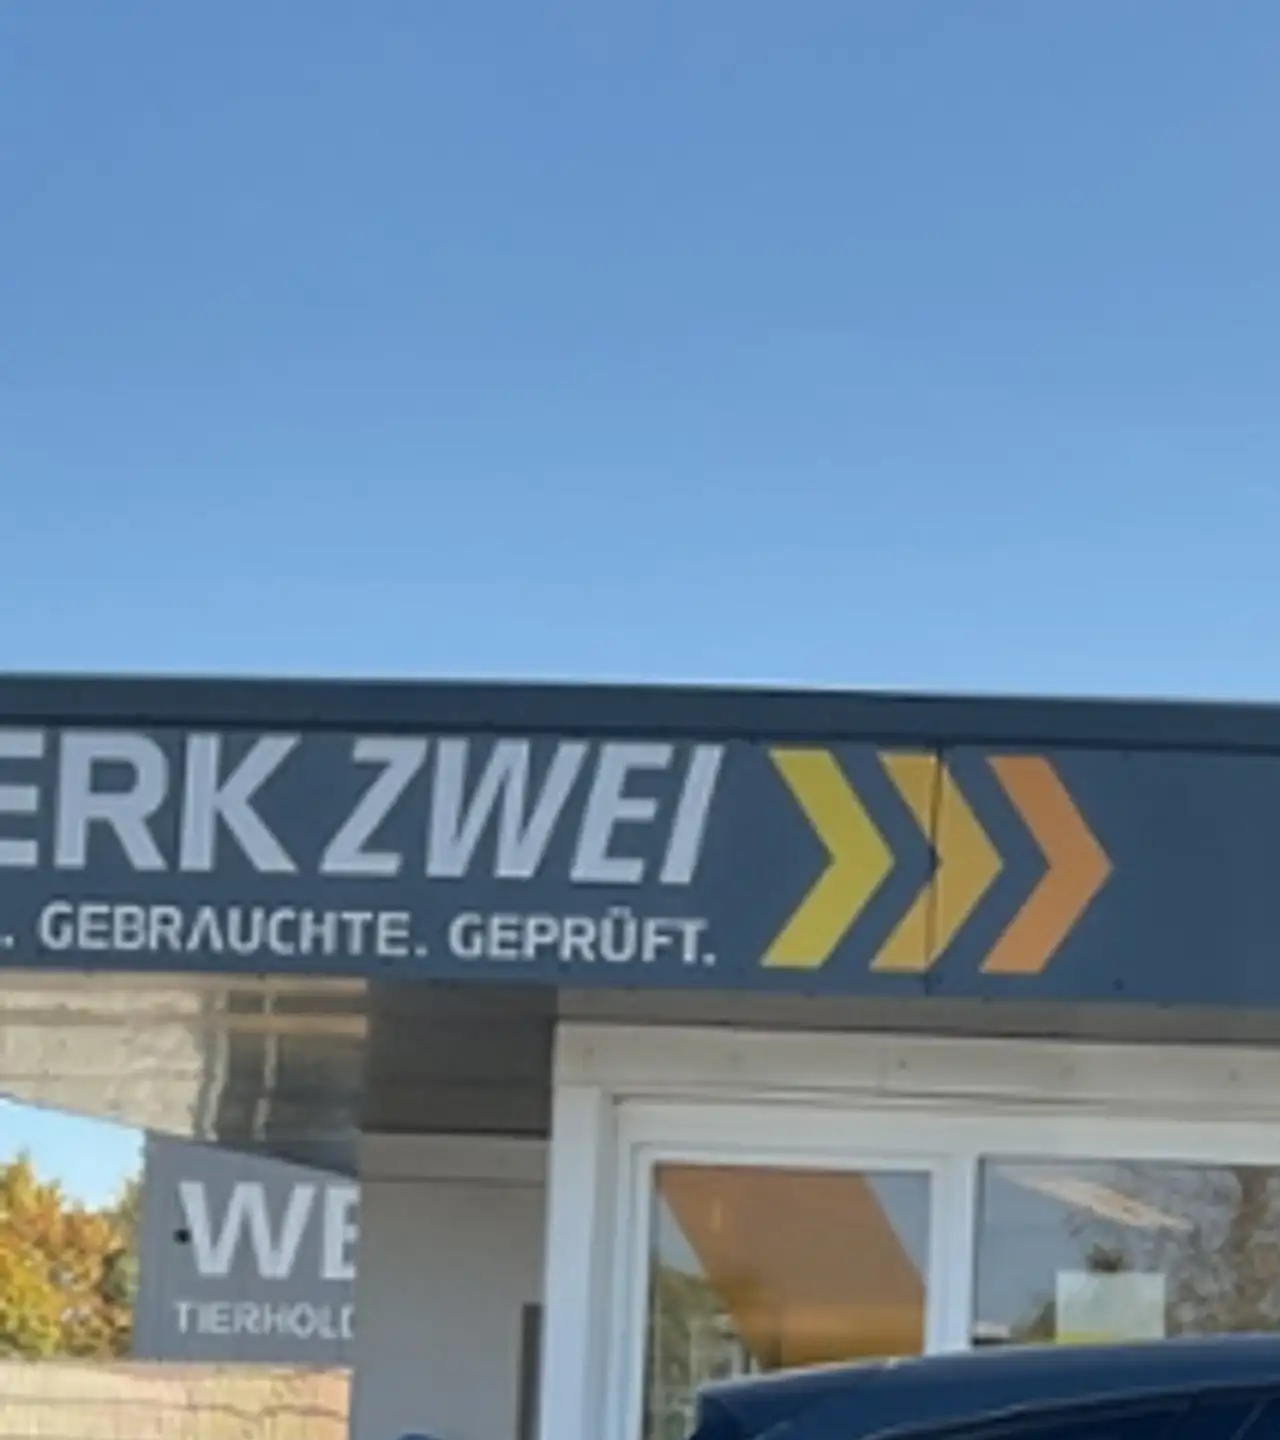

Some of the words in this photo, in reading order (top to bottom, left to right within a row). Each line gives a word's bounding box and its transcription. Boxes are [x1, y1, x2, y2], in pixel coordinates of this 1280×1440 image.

[318, 738, 725, 885] ZWEI
[39, 900, 428, 957] GEBRAUCHTE.
[448, 905, 717, 967] GEPRÜFT.
